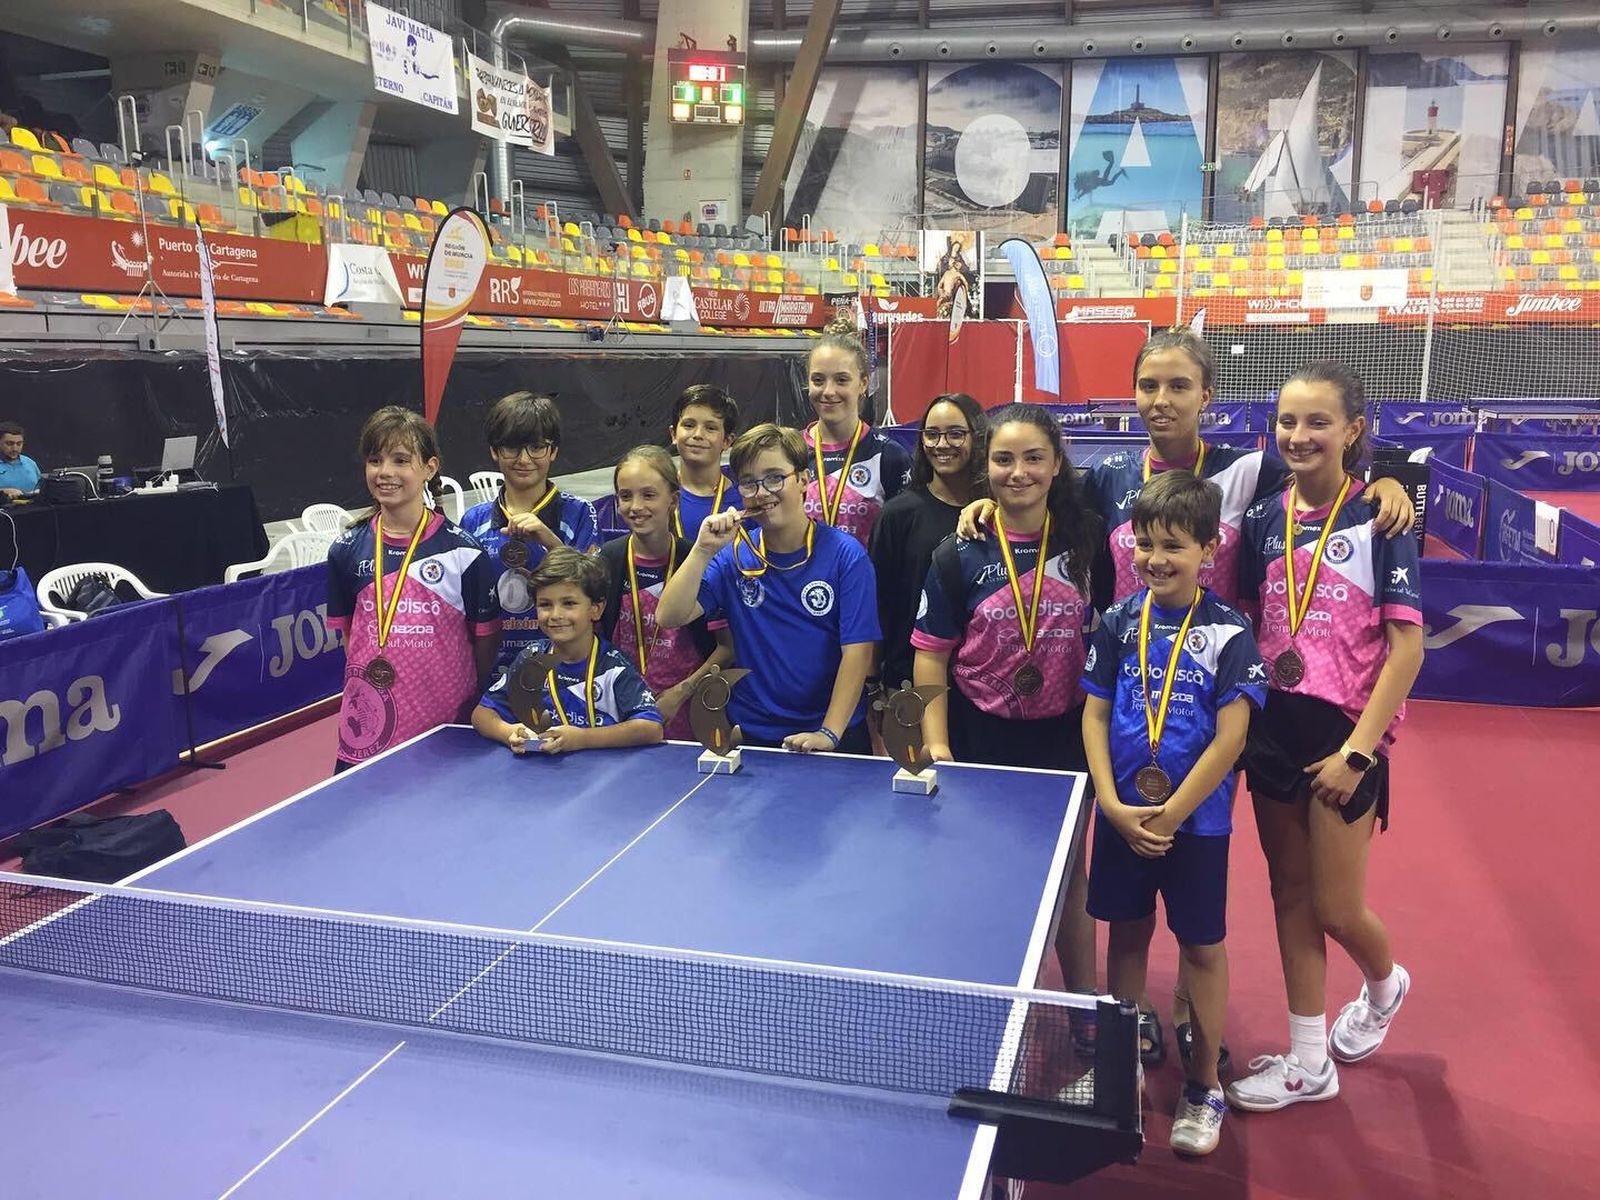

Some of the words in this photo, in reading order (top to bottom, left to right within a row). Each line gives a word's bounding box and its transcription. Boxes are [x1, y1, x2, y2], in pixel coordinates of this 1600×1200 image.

[386, 14, 406, 31] JAVI
[408, 22, 434, 43] MATÍA
[376, 76, 404, 94] TERNO
[423, 92, 453, 110] CAPITÁN
[158, 237, 192, 253] Puerto
[209, 243, 258, 260] Cartagena
[349, 262, 373, 275] Costa
[231, 275, 259, 284] Cartagena
[490, 276, 522, 305] RRS
[694, 297, 733, 311] CASTELAR
[1505, 292, 1583, 317] Jimbee
[699, 310, 728, 321] COLLEGE
[1429, 411, 1476, 428] Jom
[1557, 451, 1600, 476] Jo
[352, 740, 383, 759] JEREZ
